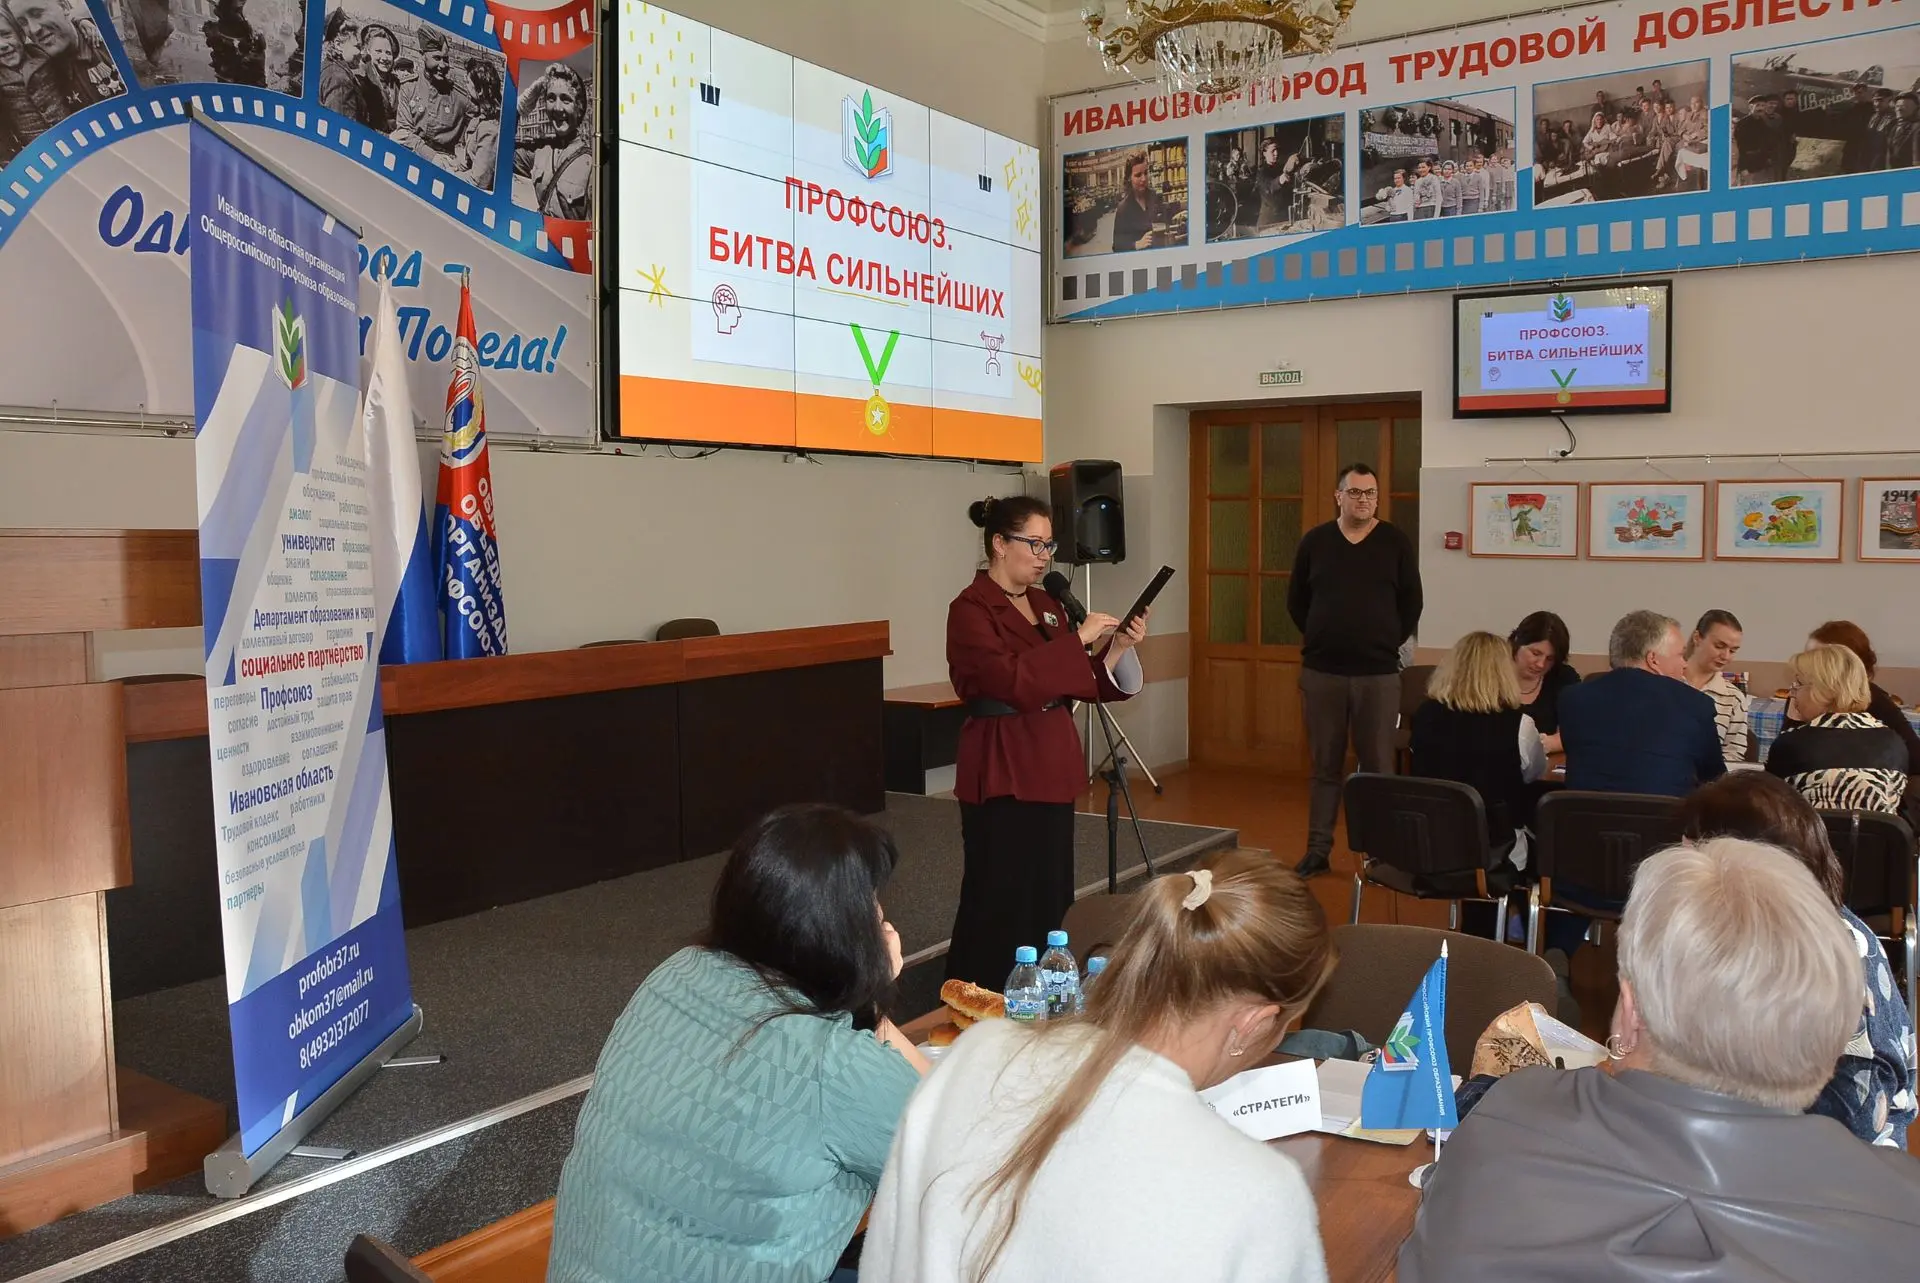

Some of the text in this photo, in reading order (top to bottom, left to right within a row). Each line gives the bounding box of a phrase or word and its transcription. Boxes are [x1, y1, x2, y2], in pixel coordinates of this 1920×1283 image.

[1063, 90, 1216, 136] ИВАНОВО
[1389, 16, 1606, 84] ТРУДОВОЙ
[785, 176, 952, 250] ПРОФСОЮЗ.
[217, 194, 346, 284] Ивановская областная организация
[201, 215, 356, 313] Общероссийского Профсоюза образования
[710, 226, 1005, 318] БИТВА СИЛЬНЕЙШИХ
[397, 307, 567, 373] Поеда!
[1519, 325, 1609, 341] ПРОФСОЮЗ.
[1488, 344, 1644, 362] БИТВА СИЛЬНЕЙШИХ
[1262, 372, 1300, 384] ВЫХОД
[289, 508, 311, 521] диалог
[281, 534, 336, 555] университет
[285, 557, 310, 569] знания
[266, 571, 292, 587] общение
[284, 591, 318, 603] коллектив
[254, 609, 308, 630] Департамент
[309, 605, 354, 626] образования
[242, 632, 313, 649] коллективный договор
[326, 628, 353, 642] гармония
[241, 651, 305, 678] социальное
[321, 672, 359, 688] стабильность
[213, 691, 256, 710] переговоры
[260, 684, 313, 713] Профсоюз
[317, 691, 353, 709] защита прав
[228, 713, 259, 734] согласие
[266, 710, 315, 733] достойный труд
[291, 720, 344, 744] взаимопонимание
[216, 740, 250, 761] ценности
[302, 740, 338, 760] соглашение
[242, 751, 291, 777] оздоровление
[229, 764, 334, 815] Ивановская область
[289, 792, 326, 818] работники
[221, 809, 279, 843] Трудовой кодекс
[246, 822, 296, 854] консолидация
[225, 841, 306, 885] безопасные условия труда
[227, 881, 265, 910] партнеры
[299, 941, 360, 1000] profobr37.ru
[288, 966, 374, 1040] obkom37@mail.ru
[299, 999, 369, 1070] 8(4932)372077
[1427, 1028, 1438, 1067] ПРОФСОЮЗ
[1432, 1067, 1445, 1116] ОБРАЗОВАНИЯ
[1232, 1093, 1311, 1117] «СТРАТЕГИ»
